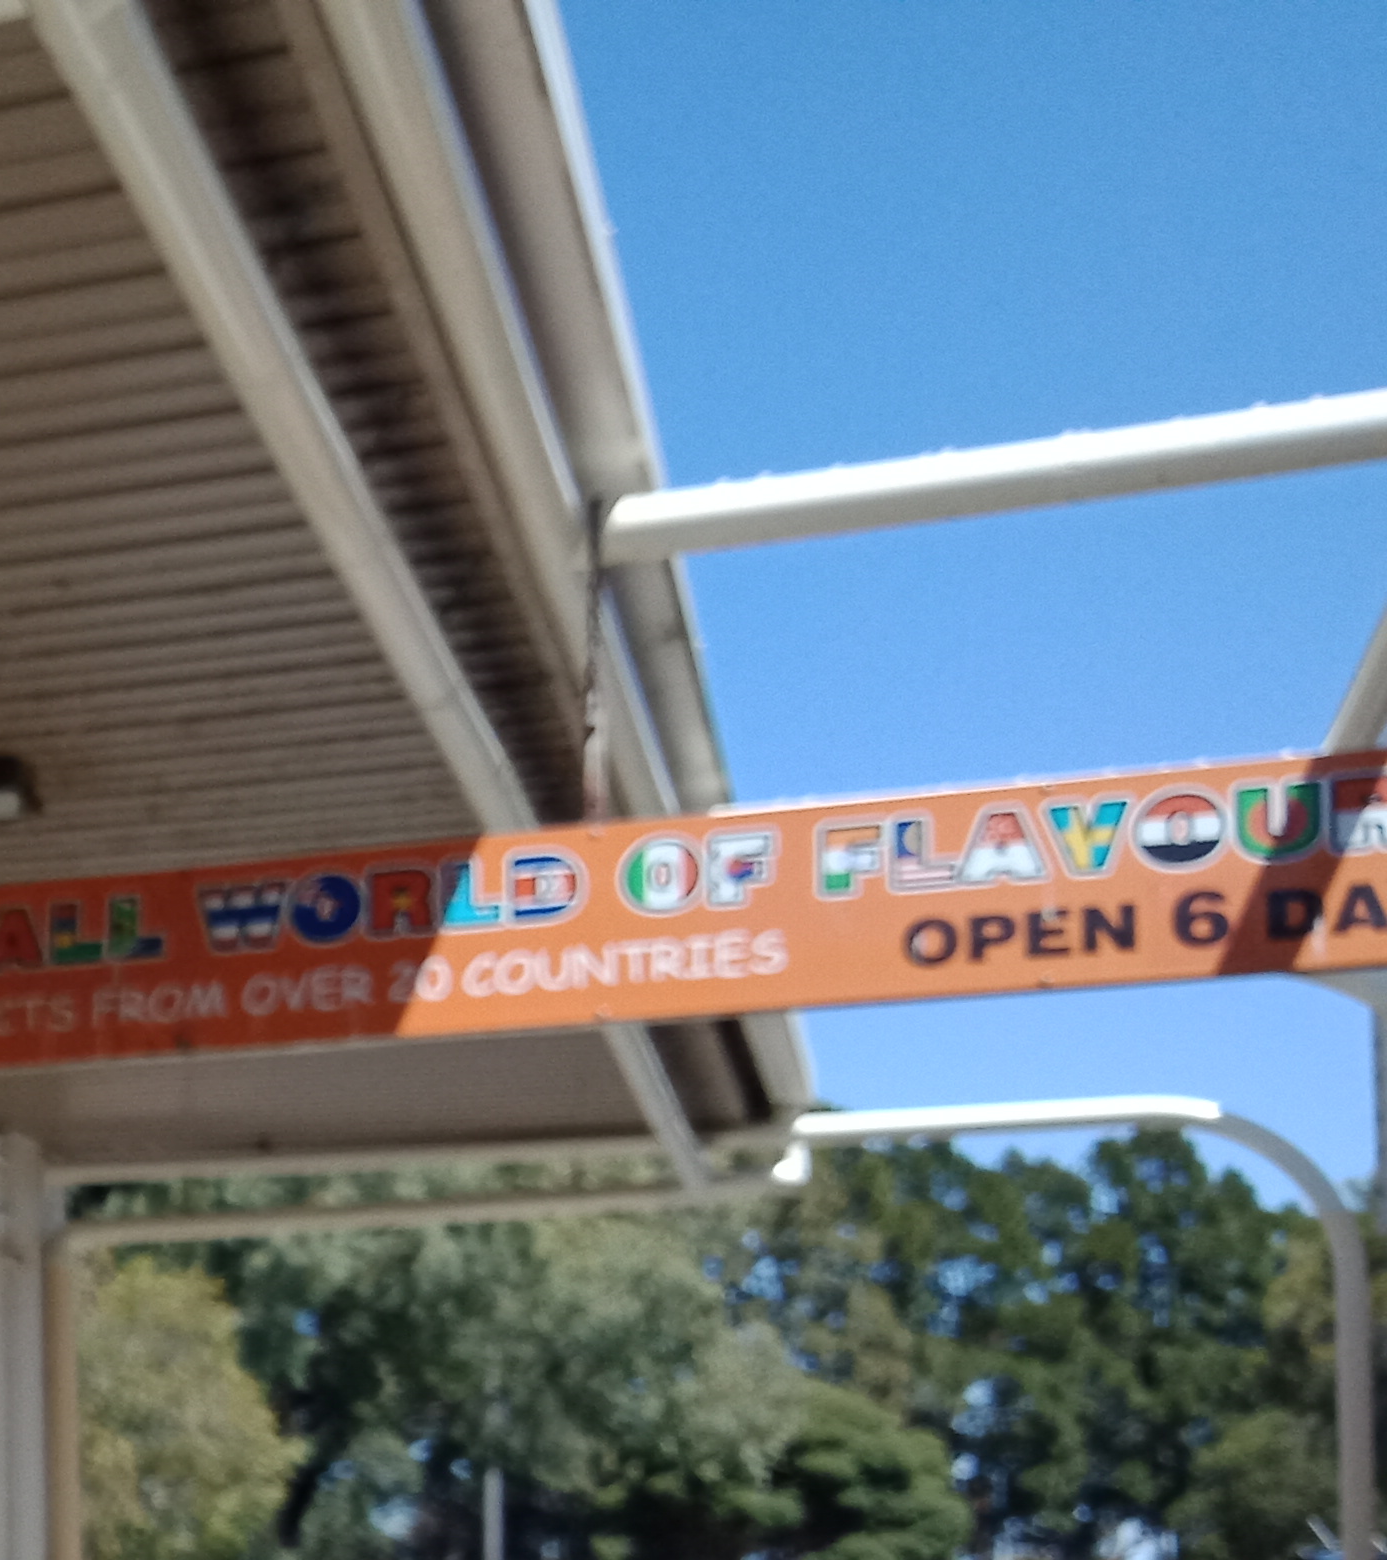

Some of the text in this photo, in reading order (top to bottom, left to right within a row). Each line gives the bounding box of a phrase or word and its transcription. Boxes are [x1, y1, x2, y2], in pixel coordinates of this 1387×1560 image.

[199, 847, 587, 957] WORLD
[617, 827, 777, 916] OF
[904, 882, 1387, 968] OPEN 6 DA
[92, 978, 226, 1030] FROM
[241, 961, 372, 1018] OVER
[388, 953, 453, 1003] 20
[460, 926, 789, 999] COUNTRIES
